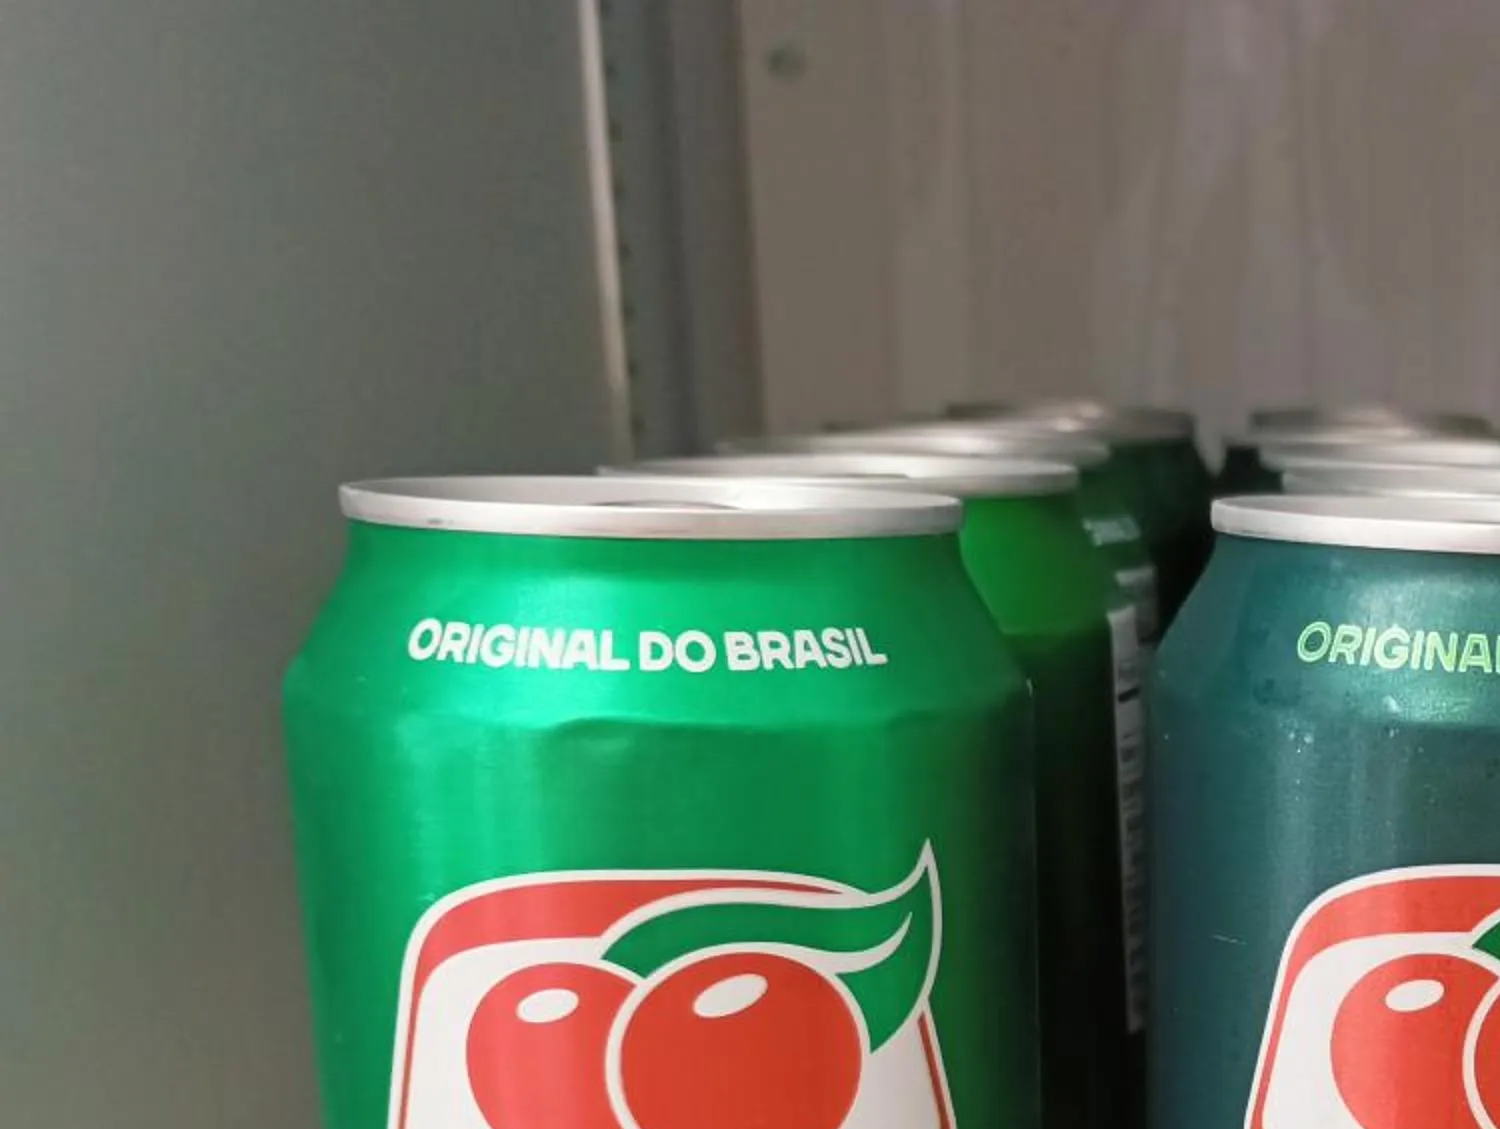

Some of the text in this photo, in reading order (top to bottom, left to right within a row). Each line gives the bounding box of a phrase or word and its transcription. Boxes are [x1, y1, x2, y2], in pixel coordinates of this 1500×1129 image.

[408, 617, 888, 672] ORIGINAL DO BRASIL
